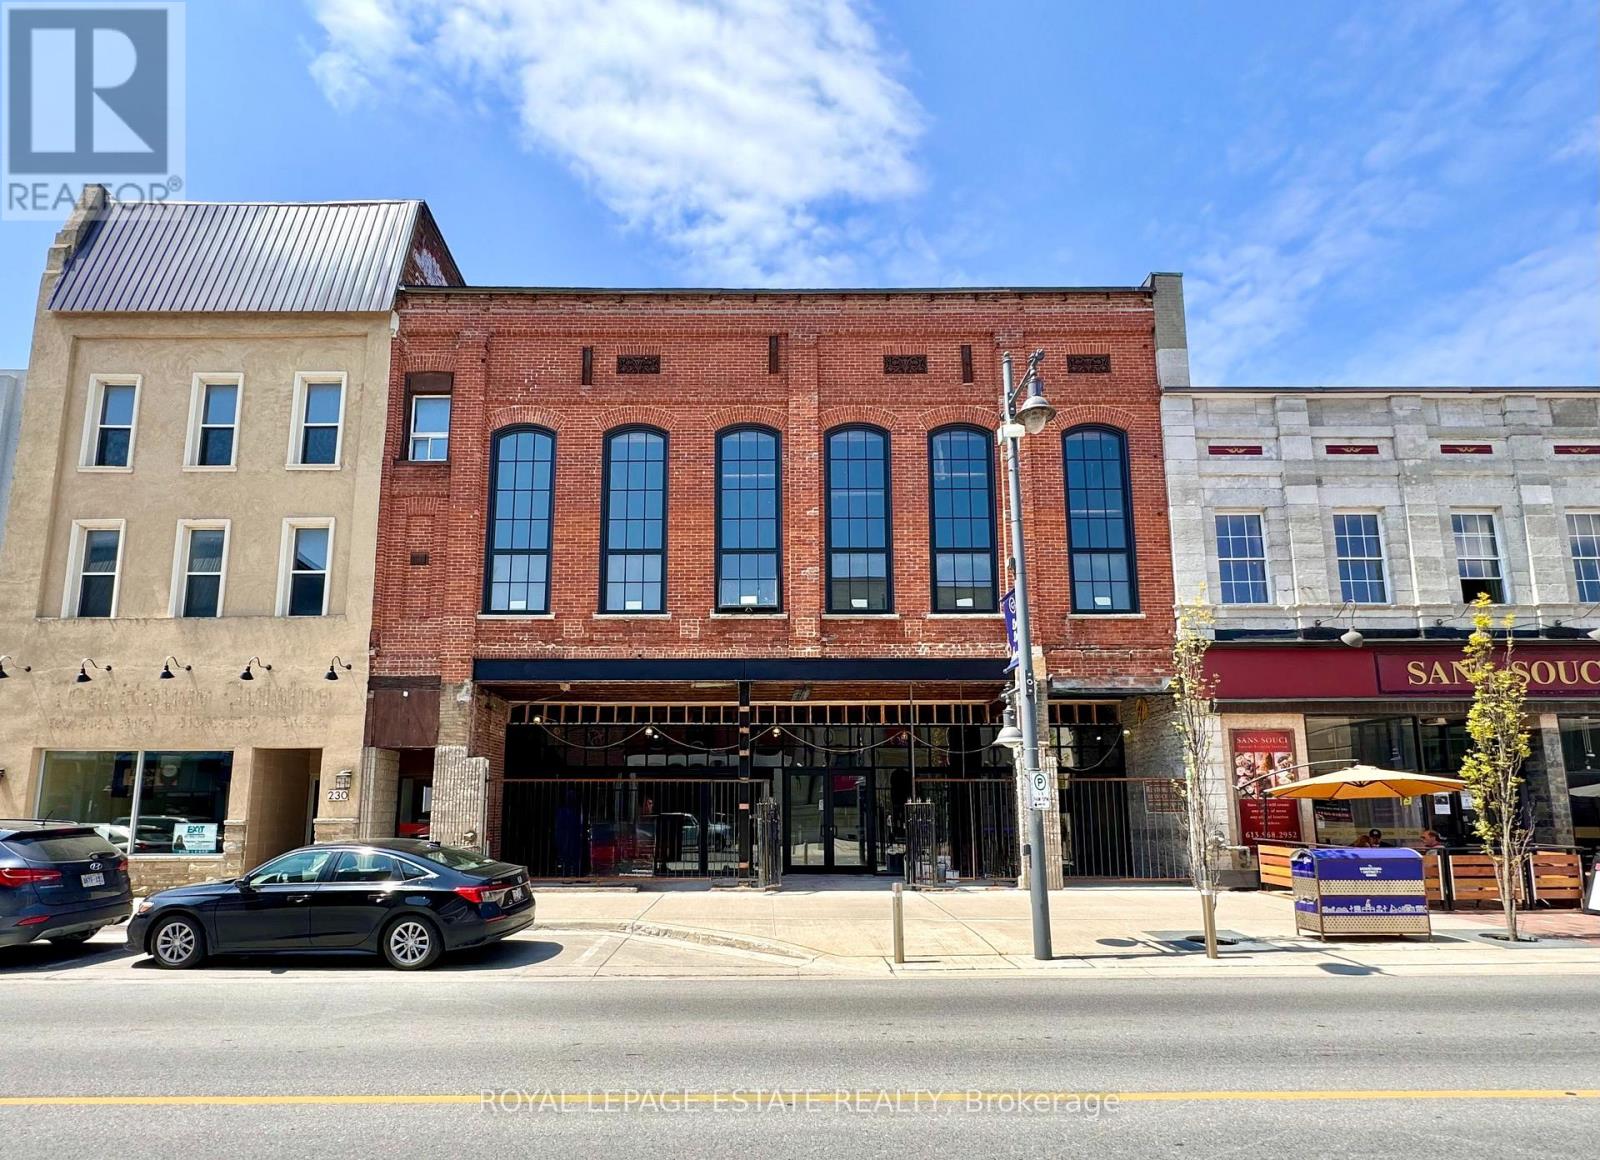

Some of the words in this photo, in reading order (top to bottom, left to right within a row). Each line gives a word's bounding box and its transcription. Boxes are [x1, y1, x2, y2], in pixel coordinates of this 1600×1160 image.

[1510, 660, 1600, 685] SOUC
[1236, 736, 1258, 744] SANS
[1261, 736, 1288, 744] SOUCI
[328, 791, 348, 800] 230
[187, 825, 206, 834] EXIT
